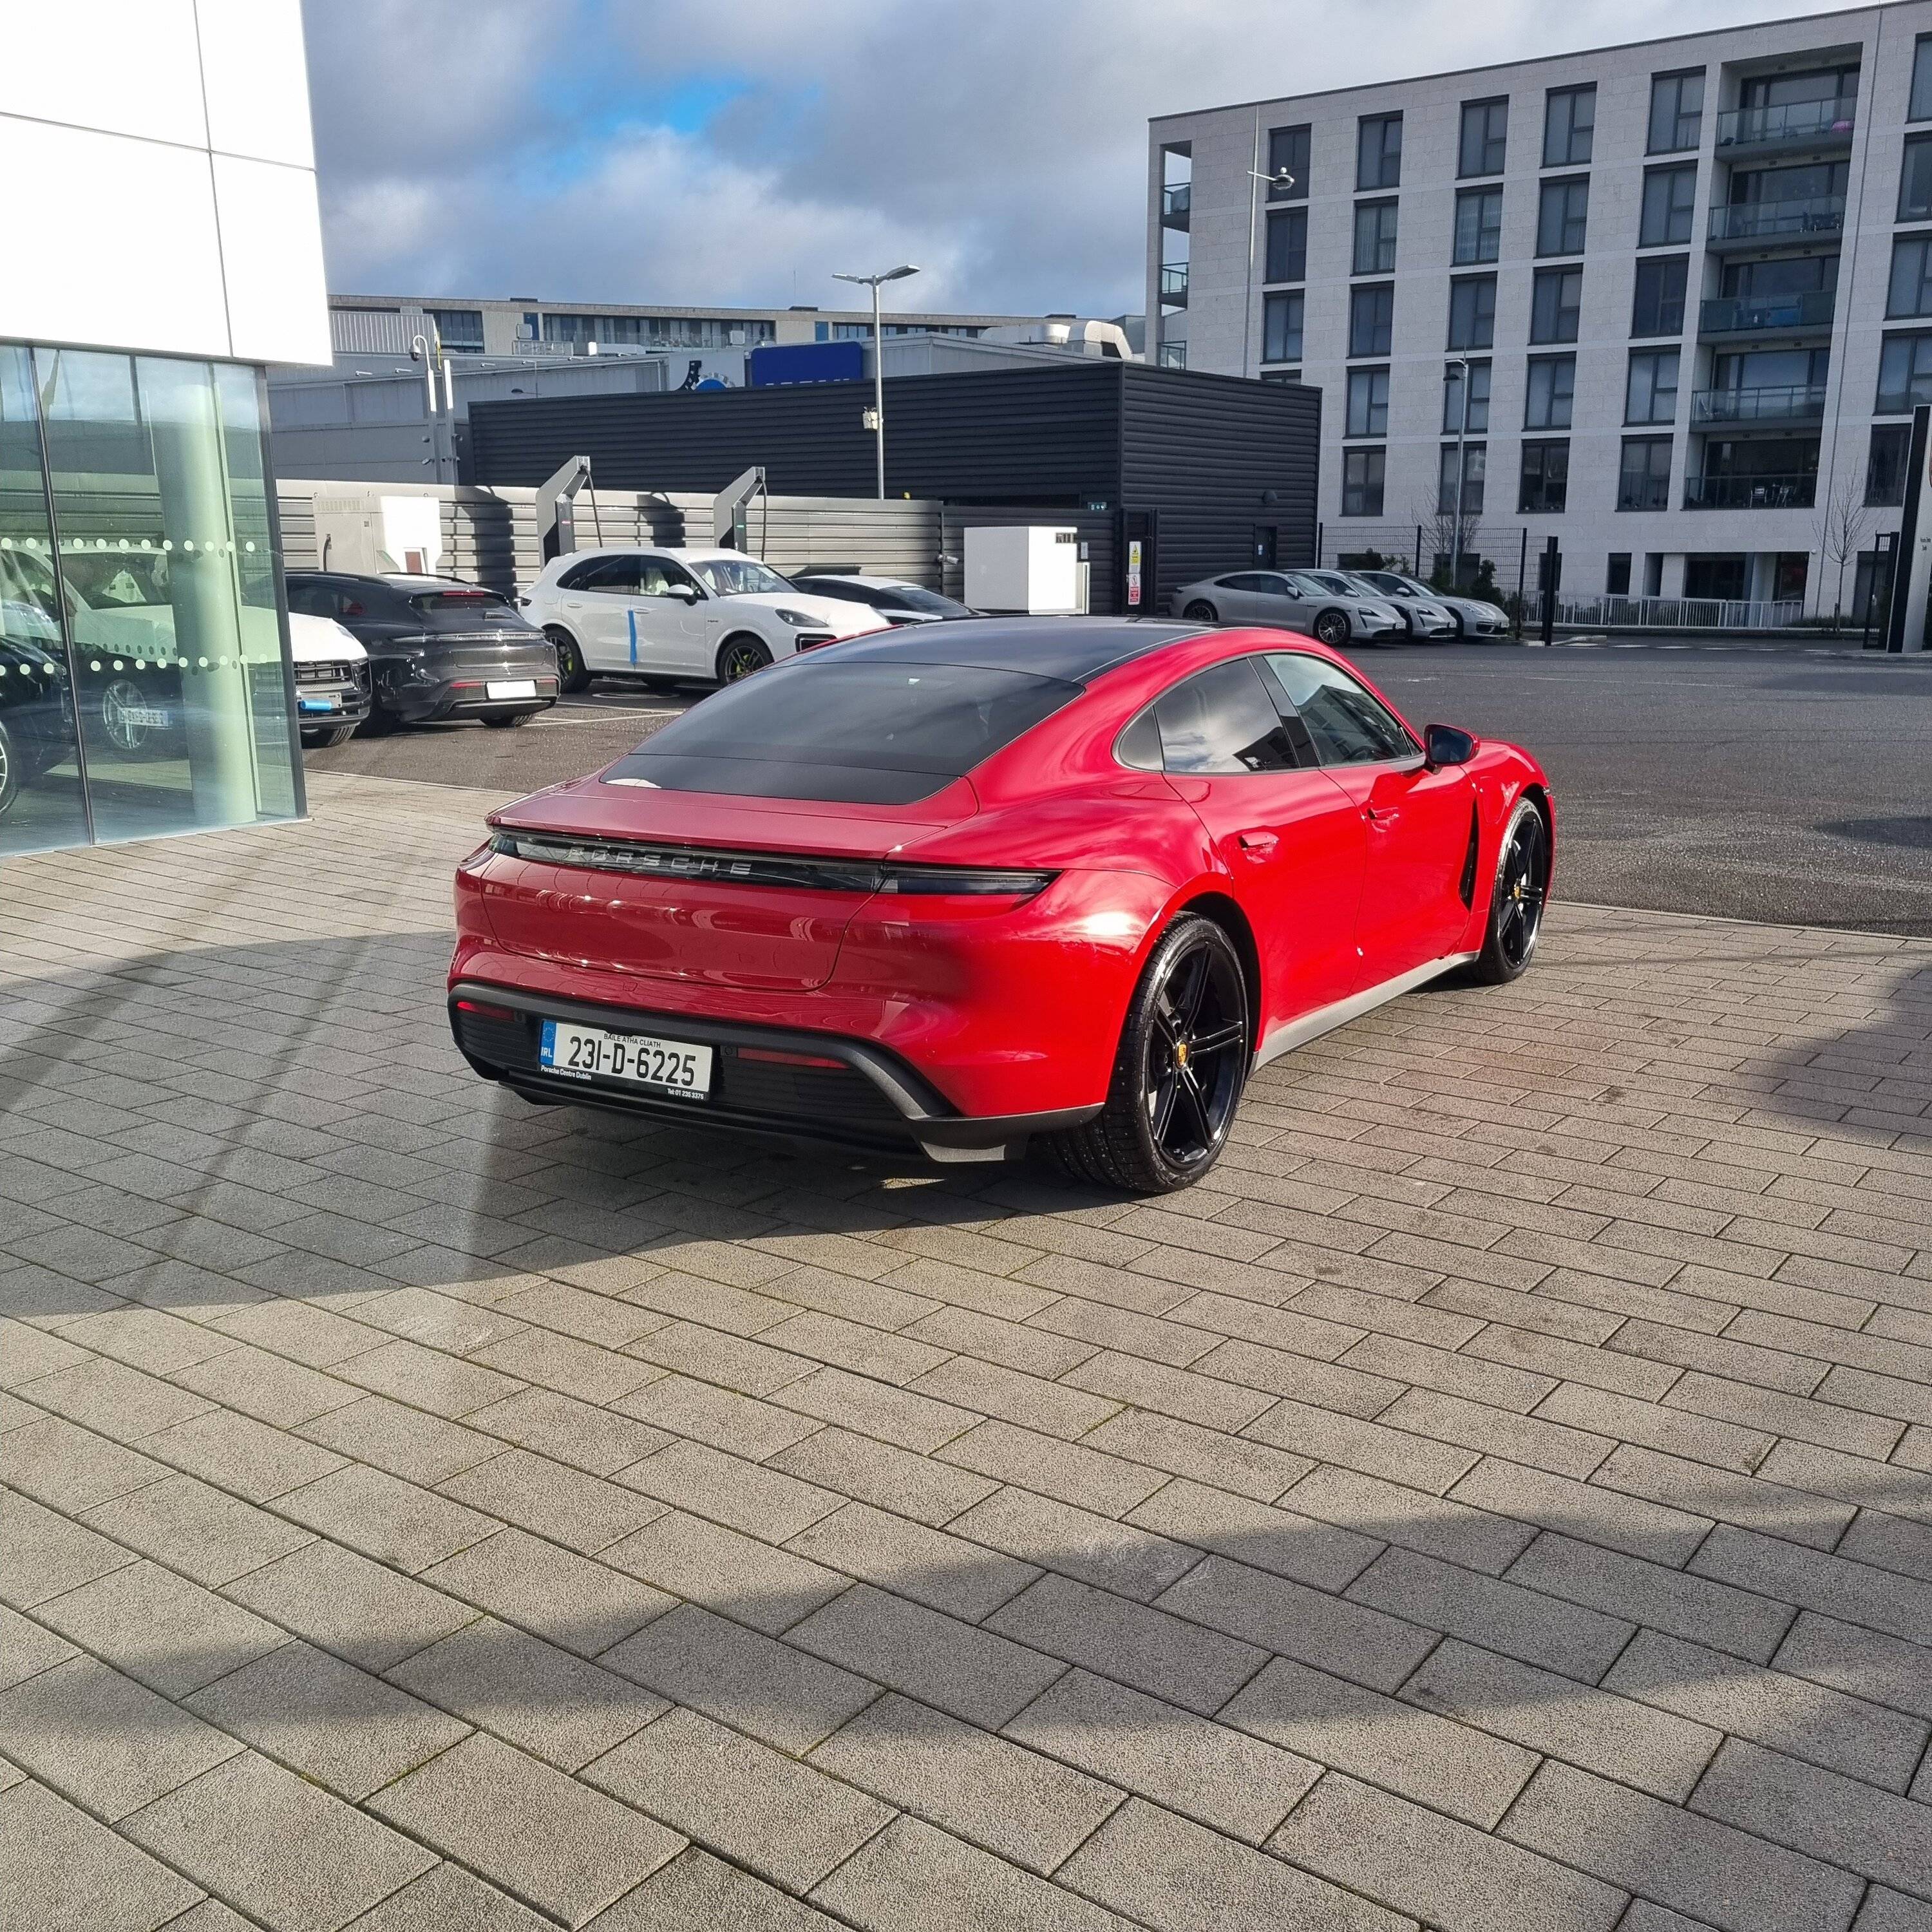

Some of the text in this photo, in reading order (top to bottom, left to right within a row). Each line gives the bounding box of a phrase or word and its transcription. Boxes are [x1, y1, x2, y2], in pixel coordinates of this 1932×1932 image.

[569, 846, 752, 875] PORSCHE
[639, 1039, 661, 1048] CLIATH
[541, 1046, 553, 1058] IRL
[567, 1036, 696, 1086] 231-D-6225
[541, 1065, 592, 1080] Porsche Centre Dublin
